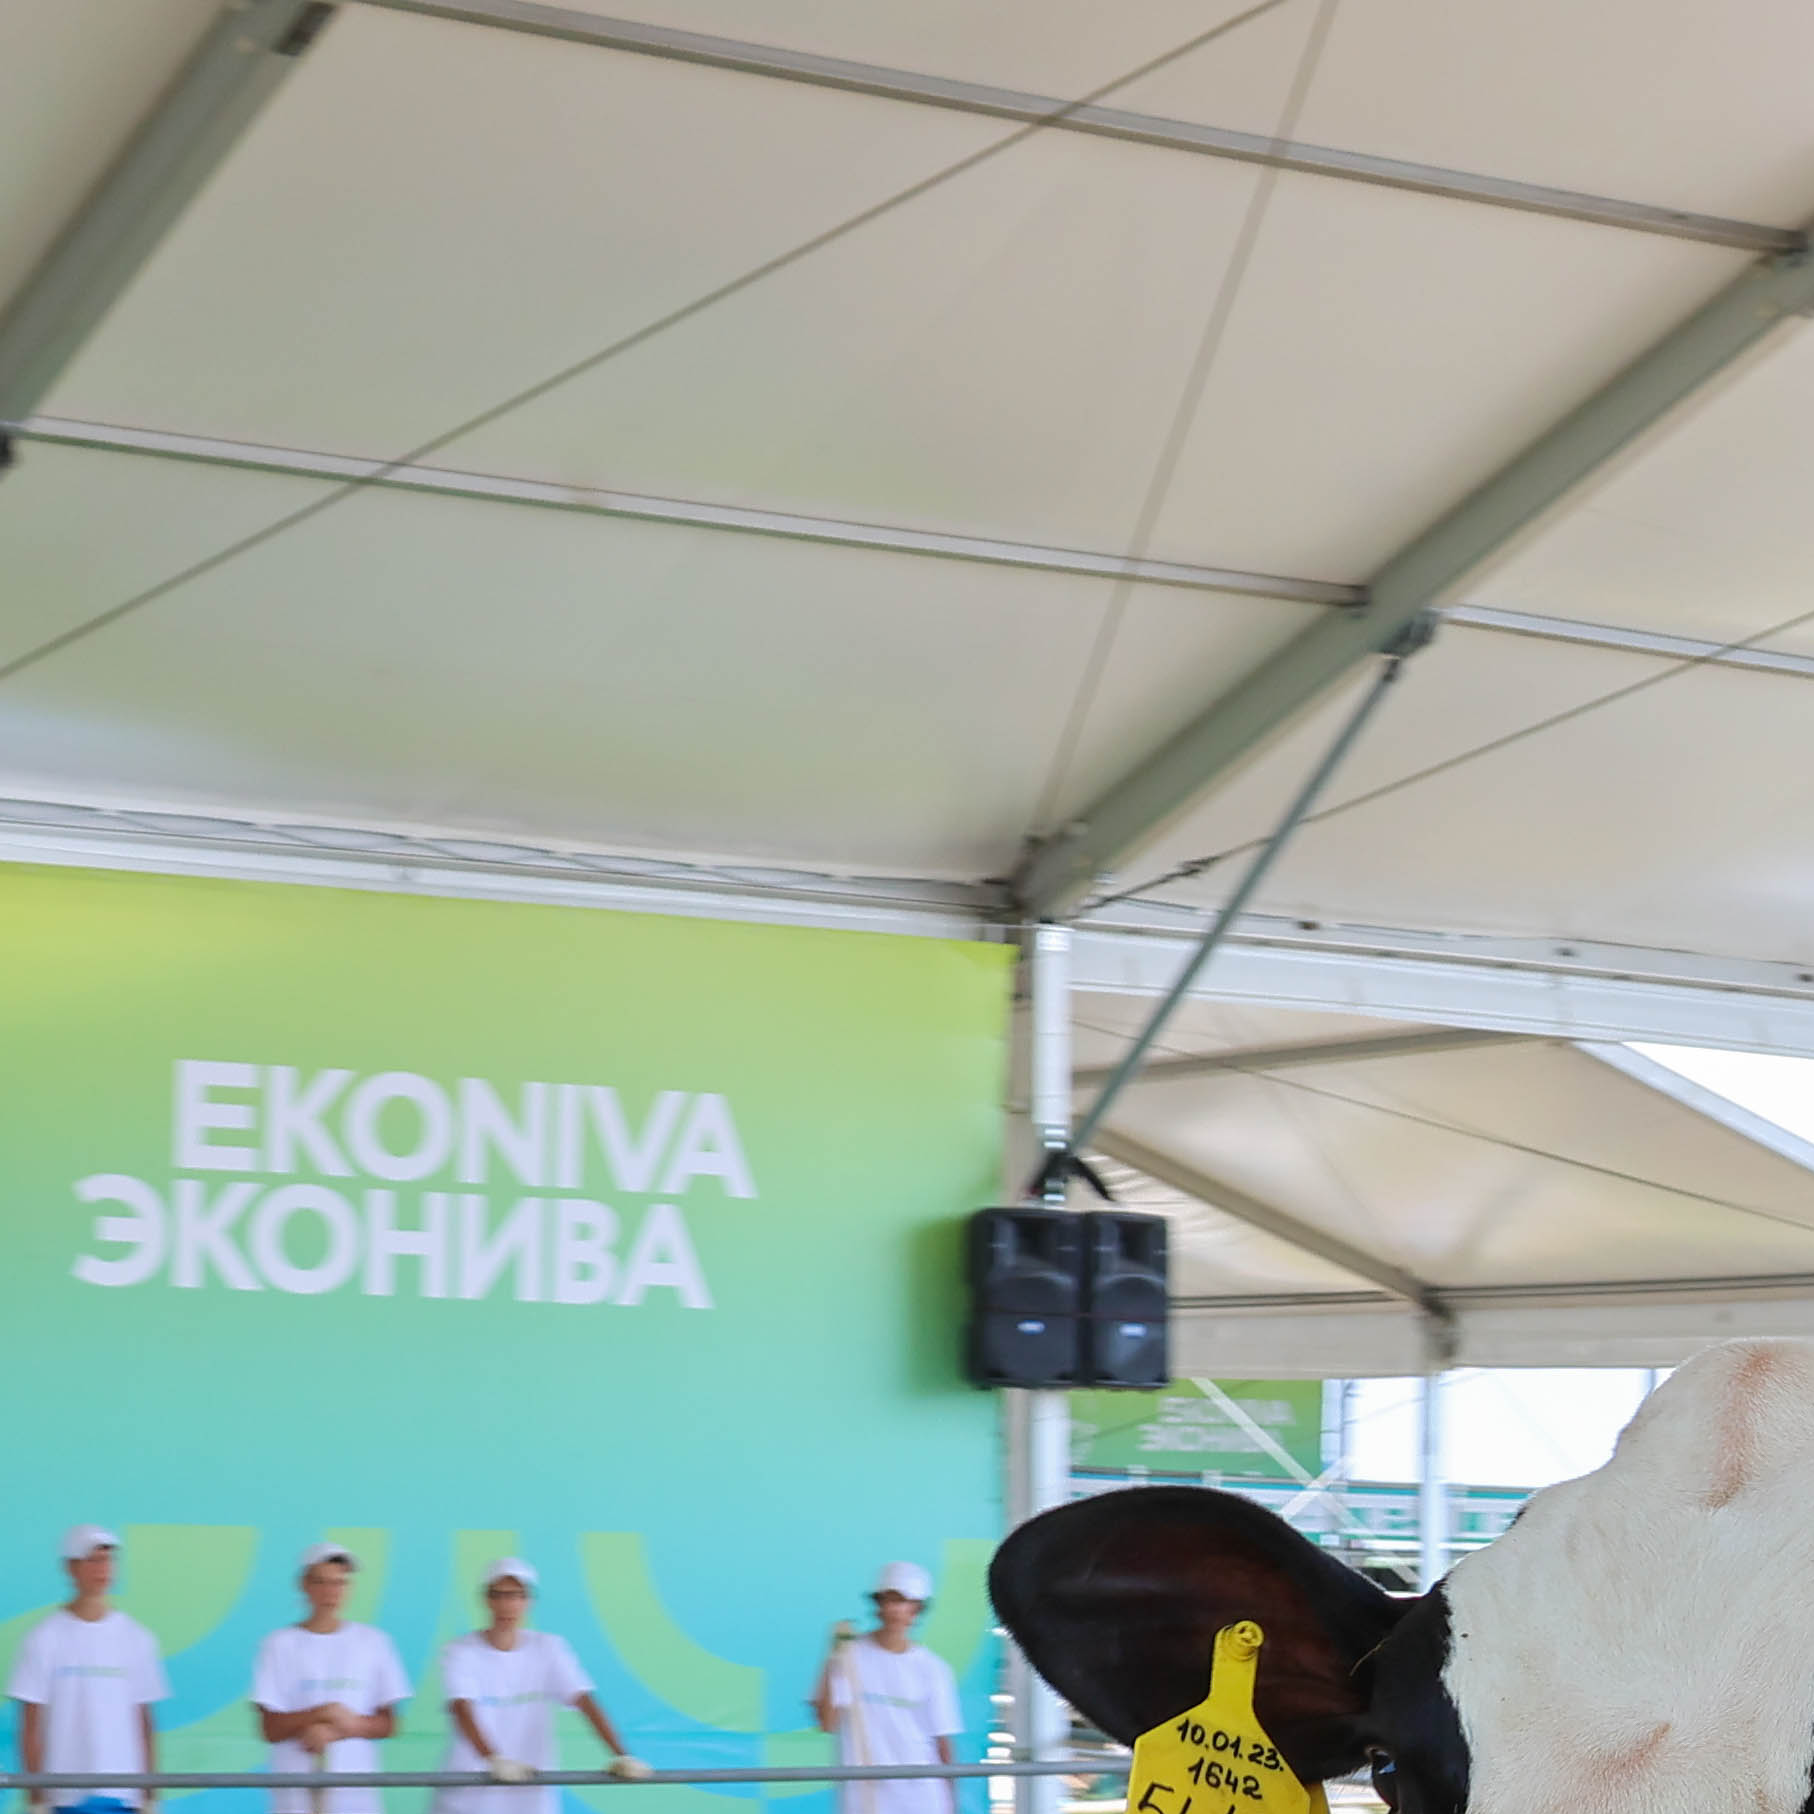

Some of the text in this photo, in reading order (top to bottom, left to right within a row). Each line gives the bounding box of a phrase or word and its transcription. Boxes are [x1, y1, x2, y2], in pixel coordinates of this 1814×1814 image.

[172, 1059, 759, 1199] EKONIVA
[70, 1173, 716, 1309] ЭКОНИВА
[1188, 1757, 1263, 1799] 1642
